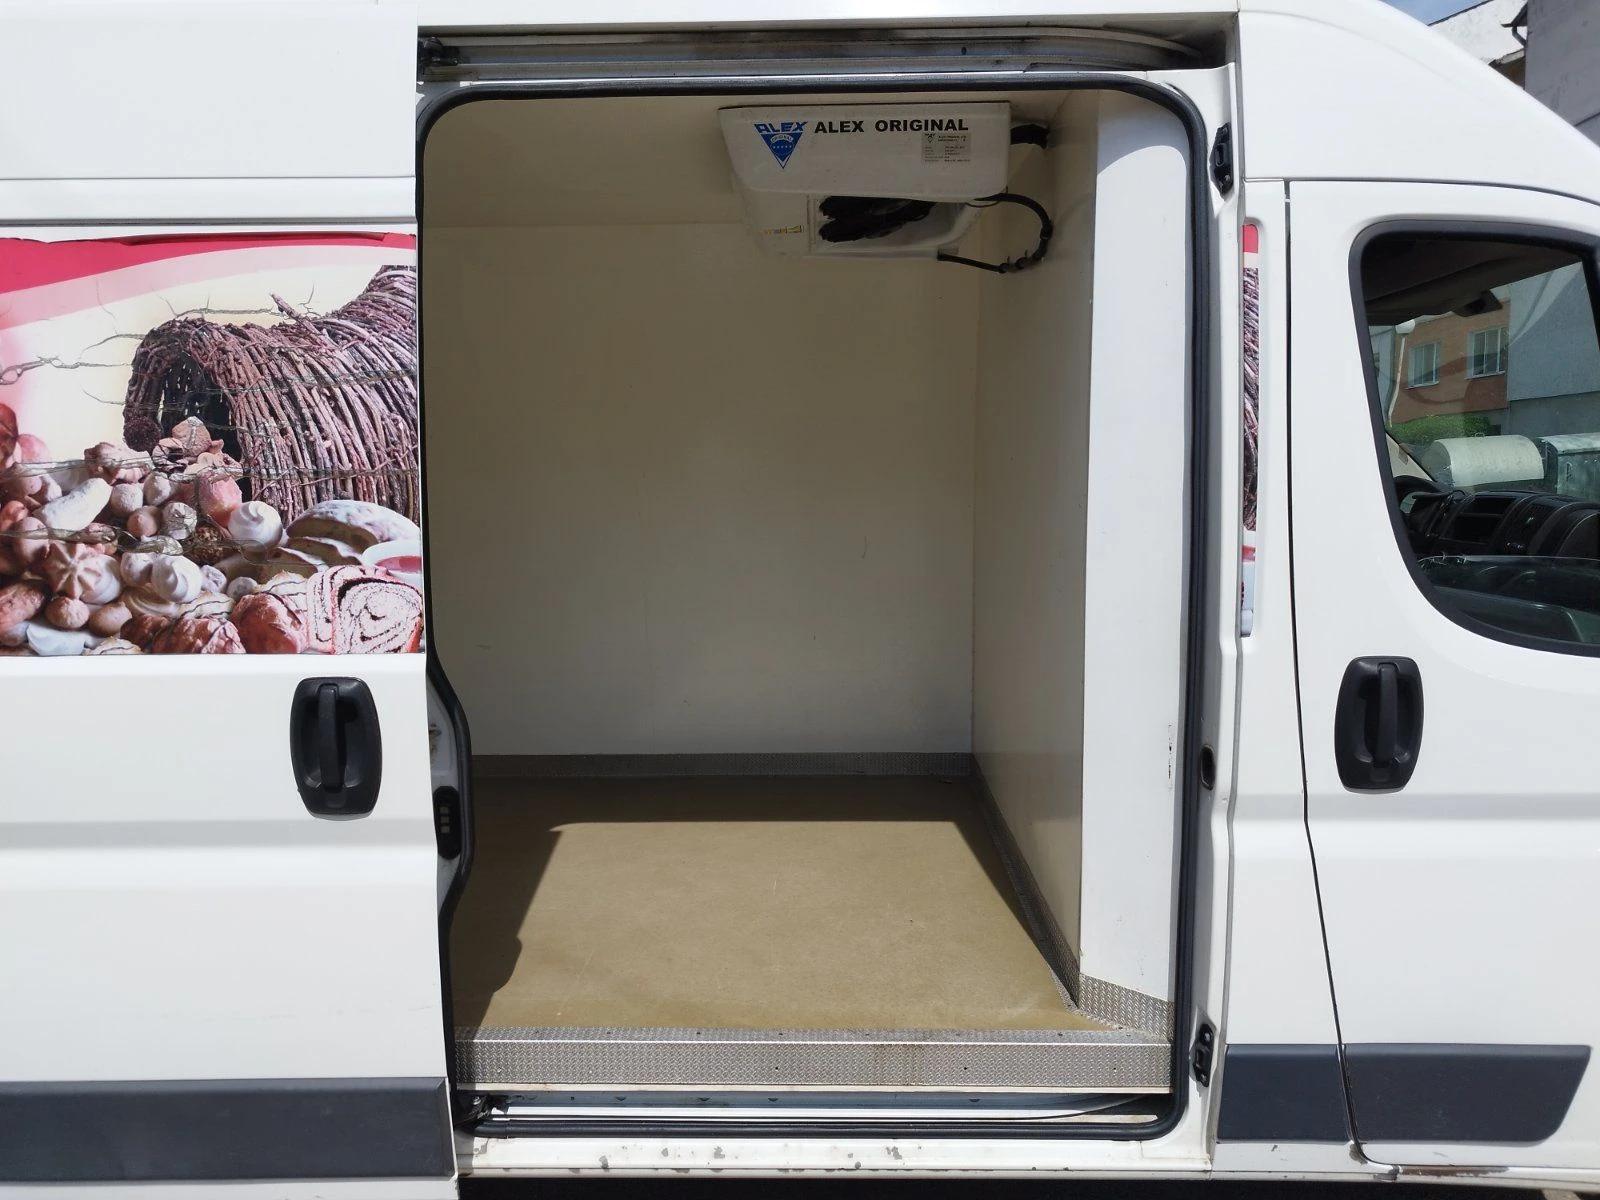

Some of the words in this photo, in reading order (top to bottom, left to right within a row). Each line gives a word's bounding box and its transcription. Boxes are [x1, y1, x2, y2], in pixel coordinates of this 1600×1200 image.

[754, 121, 807, 133] ALEX
[814, 121, 864, 133] ALEX
[874, 119, 969, 132] ORIGINAL
